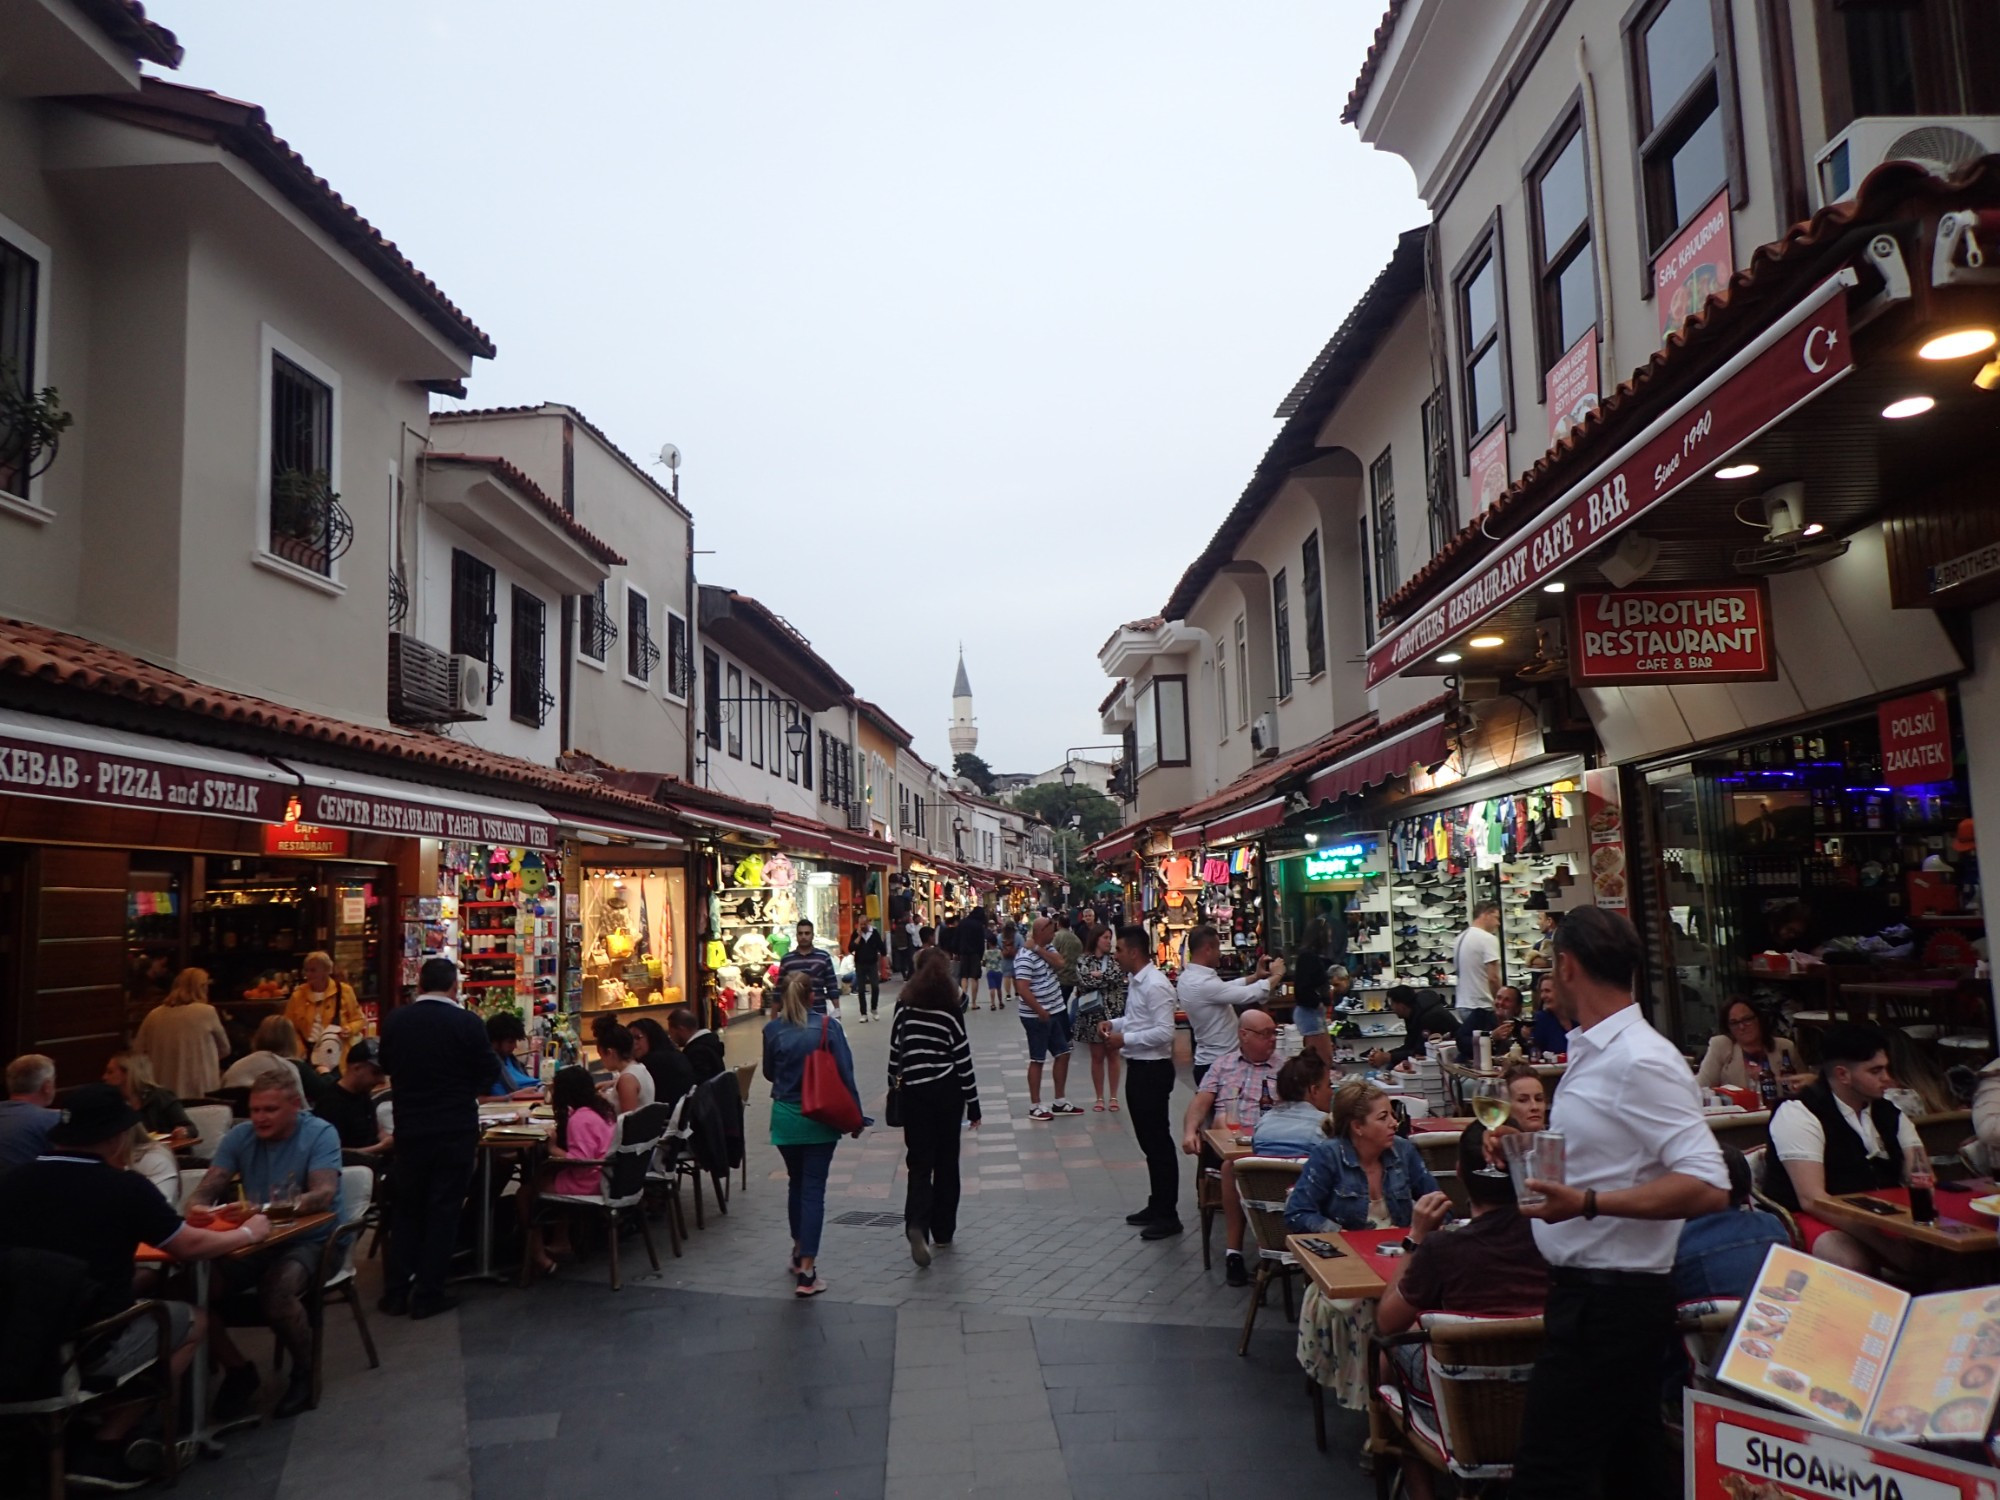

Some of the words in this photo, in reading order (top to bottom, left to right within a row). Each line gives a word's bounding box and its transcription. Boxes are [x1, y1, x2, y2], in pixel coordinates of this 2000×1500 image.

[1660, 258, 1677, 287] SAÇ
[1448, 545, 1528, 629] RESTAURANT
[1532, 512, 1574, 573] CAFE
[1587, 473, 1630, 534] BAR
[1654, 453, 1680, 490] Since
[1684, 410, 1712, 458] 1990
[1585, 627, 1757, 657] RESTAURANT
[1636, 657, 1668, 670] CAFE
[1674, 657, 1684, 669] &
[1688, 656, 1713, 669] BAR
[1886, 743, 1945, 771] ZAKATEK
[0, 747, 78, 789] KEBAB
[97, 761, 163, 801] PIZZA
[168, 781, 198, 806] and
[203, 778, 260, 813] STEAK
[317, 794, 370, 826] CENTER
[372, 803, 445, 834] RESTAURANT
[278, 841, 334, 851] RESTAURANT
[1746, 1436, 1905, 1500] SHOARMA
